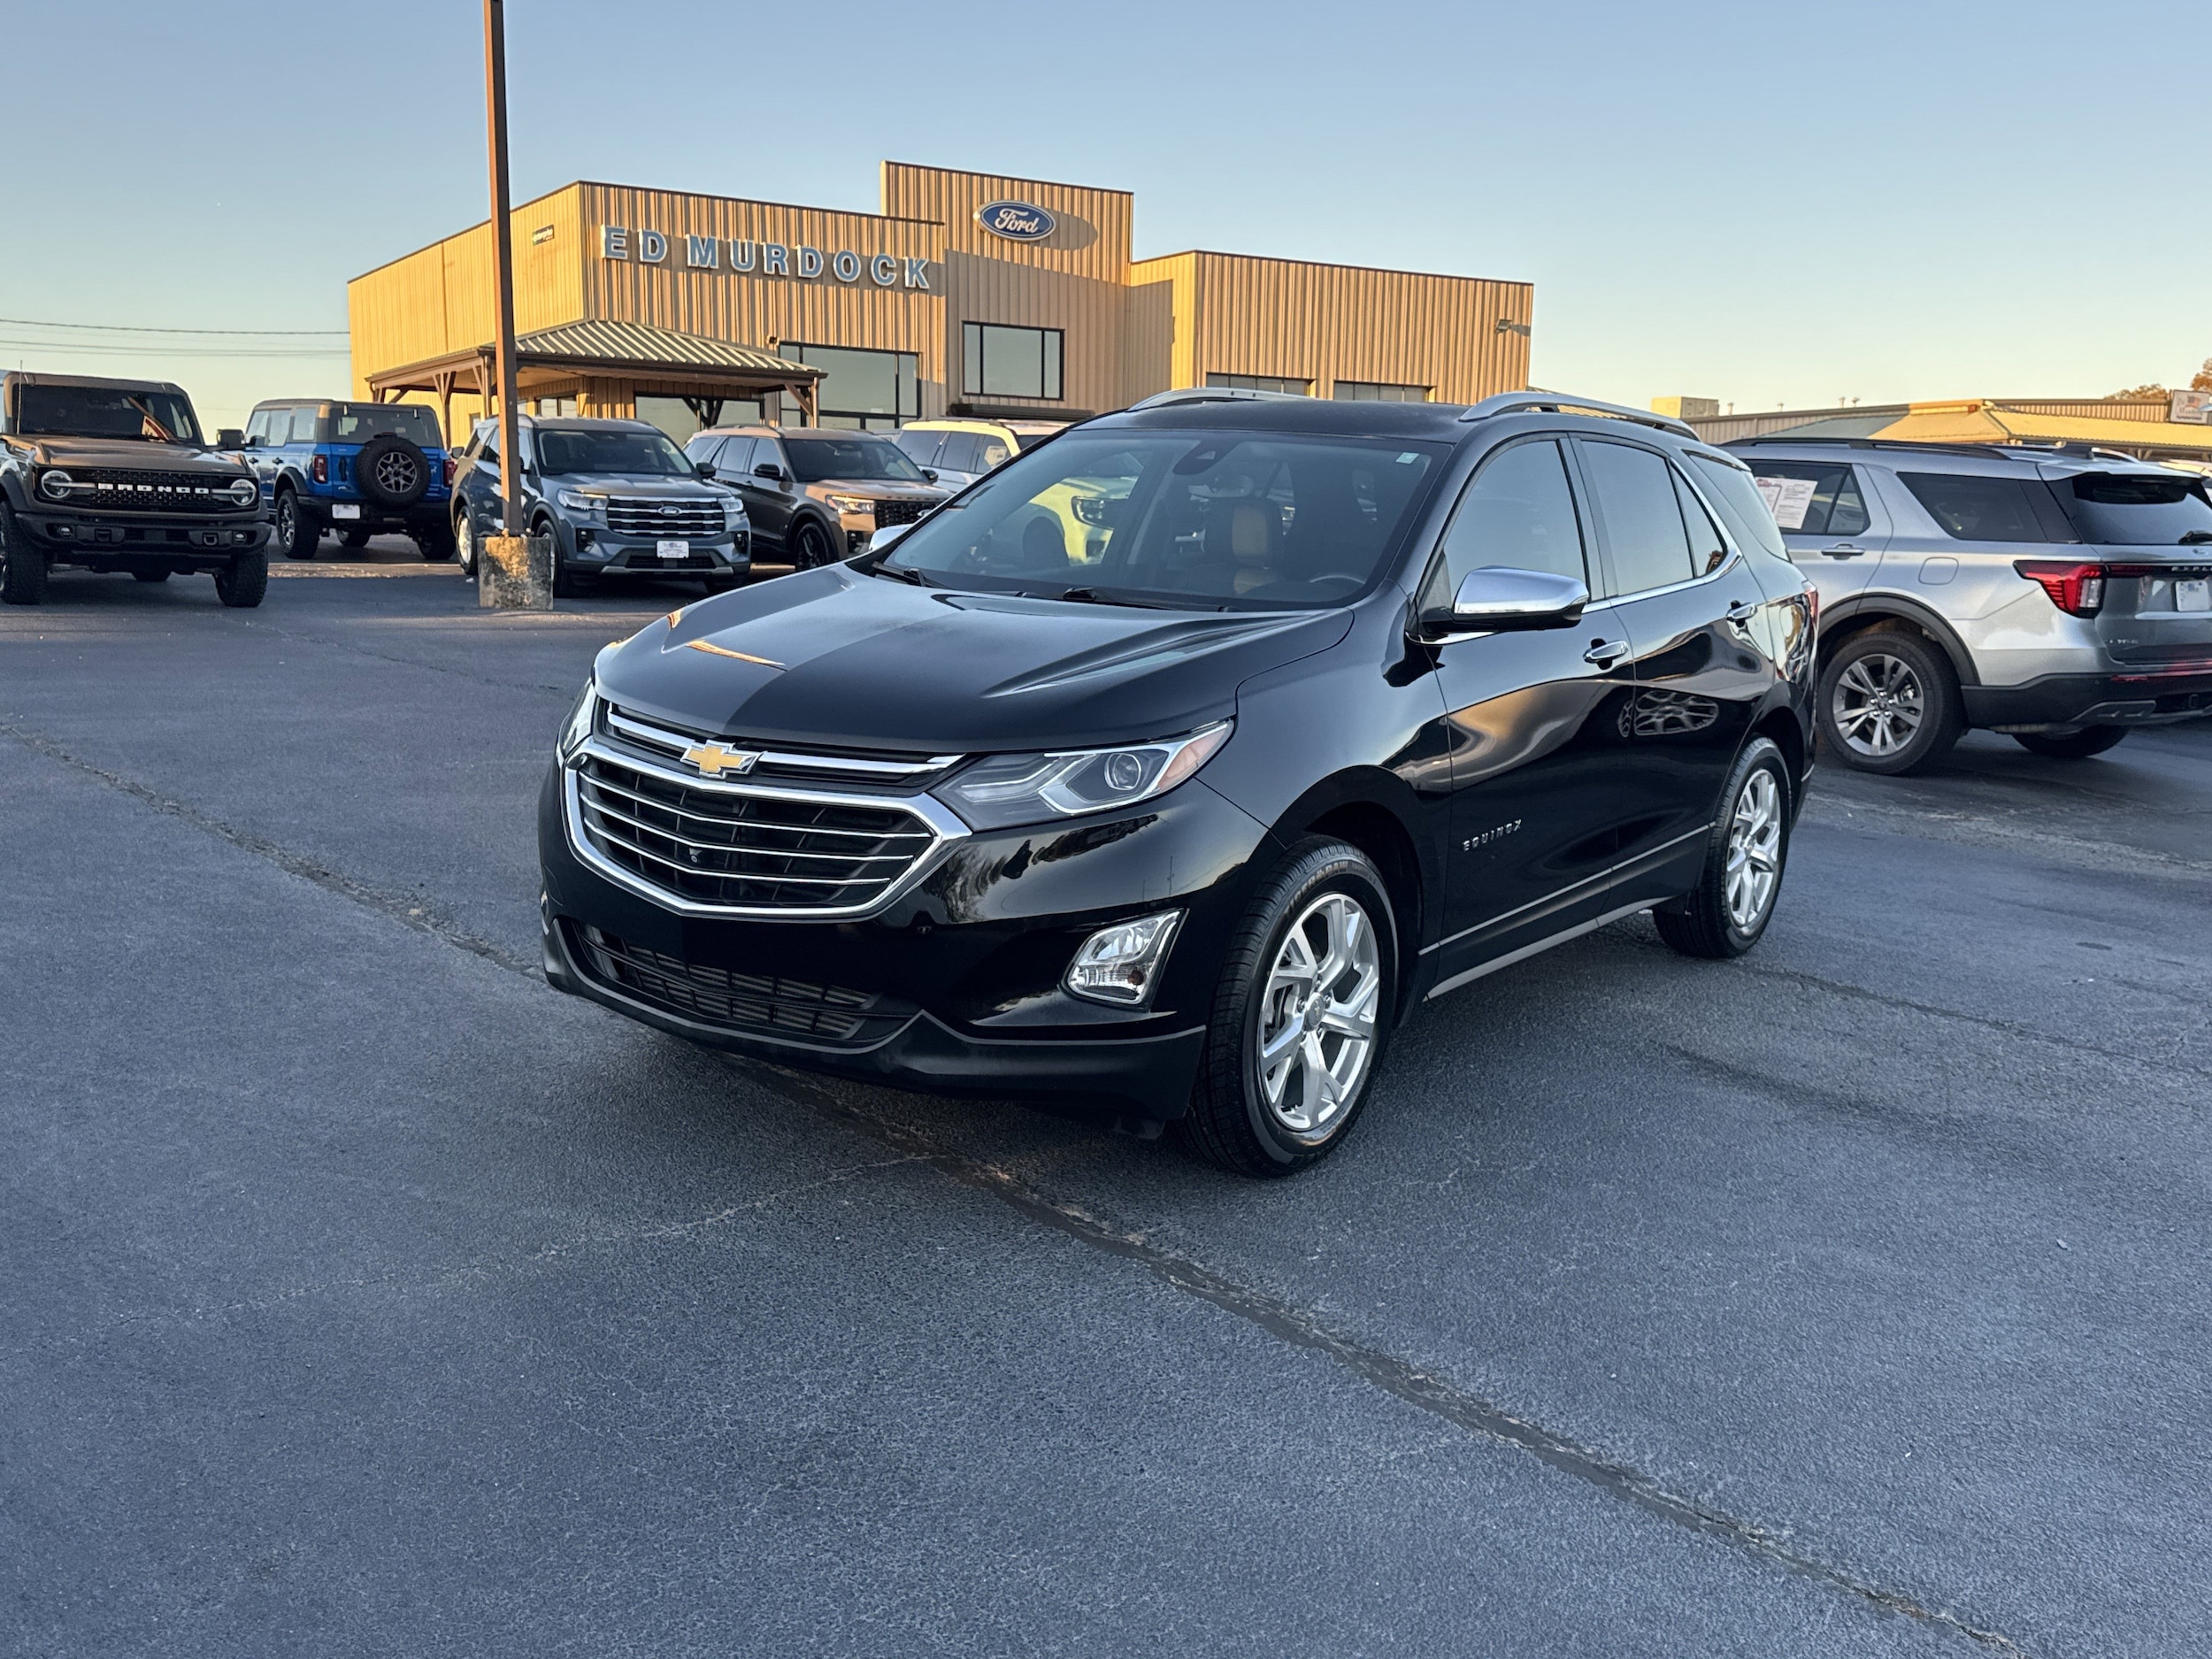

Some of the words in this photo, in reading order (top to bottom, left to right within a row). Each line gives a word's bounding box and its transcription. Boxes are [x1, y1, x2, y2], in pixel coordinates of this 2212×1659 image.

[995, 208, 1040, 234] Ford
[600, 224, 668, 263] ED
[685, 233, 931, 289] MURDOCK
[97, 482, 210, 495] BRONCO
[1463, 818, 1522, 851] EQUINOX
